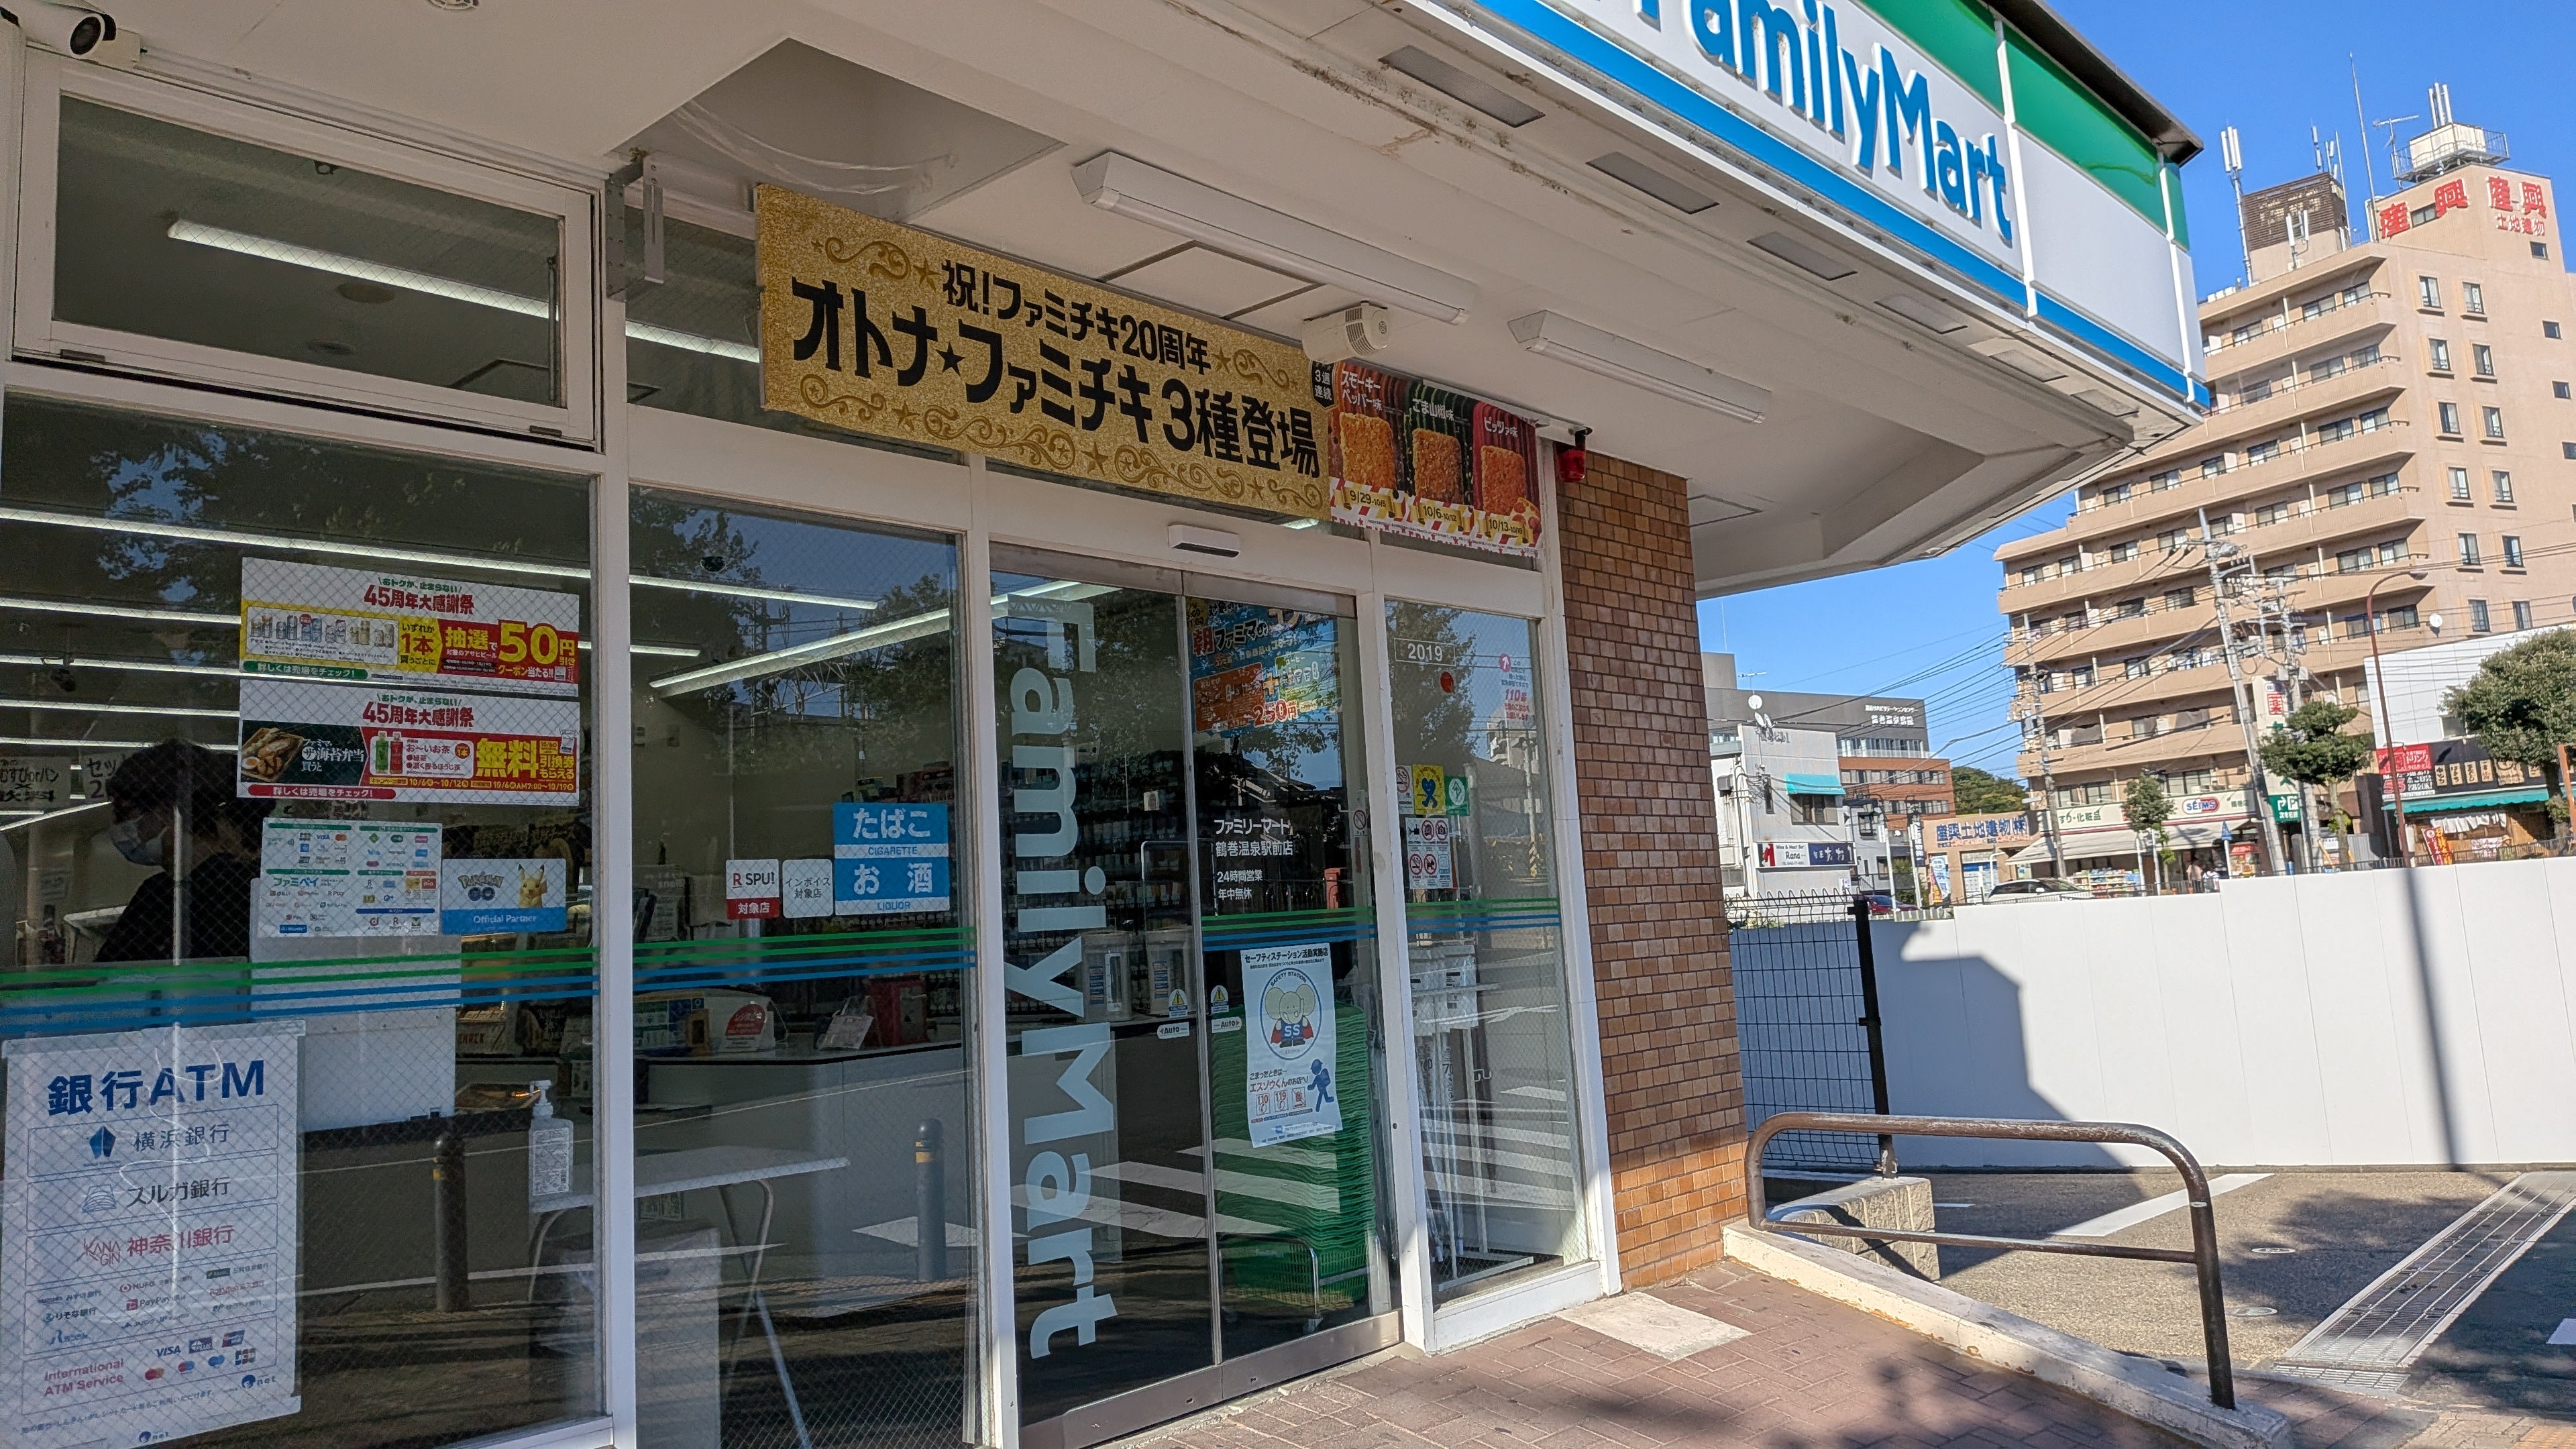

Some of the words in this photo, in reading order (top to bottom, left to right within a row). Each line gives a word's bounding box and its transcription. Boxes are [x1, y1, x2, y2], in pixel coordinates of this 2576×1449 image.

[1633, 0, 2012, 248] amilyMart
[1315, 370, 1331, 384] 3週
[1342, 370, 1381, 393] スモーキー
[1315, 385, 1332, 400] 連続
[1342, 389, 1383, 411] ペッパー味
[1412, 398, 1455, 421] ごま山椒味
[1483, 417, 1519, 437] ピッツァ味
[364, 585, 474, 614] 45周年大感謝祭
[402, 624, 435, 633] いずれか
[400, 633, 434, 655] 1本
[400, 654, 436, 665] 買うごとに
[1407, 643, 1443, 662] 2019
[258, 662, 356, 678] 詳しくは売場をチェック!
[1505, 688, 1527, 702] 110番
[363, 702, 474, 727] 45周年大感謝祭
[476, 738, 538, 779] 無料
[539, 755, 574, 768] 引換券
[301, 761, 322, 771] 買うと
[539, 768, 575, 780] もらえる
[272, 786, 373, 798] 詳しくは売場をチェック!
[2186, 800, 2216, 811] SEIMS
[853, 808, 930, 839] たばこ
[1214, 818, 1289, 835] ファミリーマート
[868, 846, 918, 855] CIGARETTE
[1215, 841, 1293, 857] 鶴巻温泉駅前店
[272, 877, 319, 888] ファミペイ
[745, 871, 775, 885] SPU!
[785, 877, 831, 887] インボイス
[1217, 869, 1263, 883] 24時間営業
[468, 886, 495, 902] GO
[794, 888, 822, 899] 対象店
[1218, 888, 1252, 901] 年中無休
[738, 902, 770, 914] 対象店
[877, 902, 911, 911] LIQUOR
[473, 914, 504, 924] Official
[506, 914, 537, 923] Partner
[1244, 947, 1329, 964] セーフティステーション活動実施店
[1004, 600, 1118, 1359] FamilyMart
[1270, 971, 1287, 987] SAFETY
[1287, 971, 1307, 983] STATION
[1164, 1026, 1180, 1034] Auto
[1221, 1020, 1236, 1028] Auto
[1284, 1024, 1301, 1037] SS
[48, 1060, 264, 1116] 銀行ATM
[1257, 1094, 1269, 1105] 110
[1275, 1091, 1287, 1102] 119
[133, 1123, 230, 1152] 横浜銀行
[127, 1177, 231, 1208] スルガ銀行
[85, 1239, 121, 1256] KANA
[140, 1296, 170, 1307] PayPay
[56, 1307, 98, 1320] りそな銀行
[155, 1345, 182, 1358] VISA
[44, 1358, 124, 1381] International
[44, 1382, 73, 1397] ATM
[77, 1374, 124, 1391] Service
